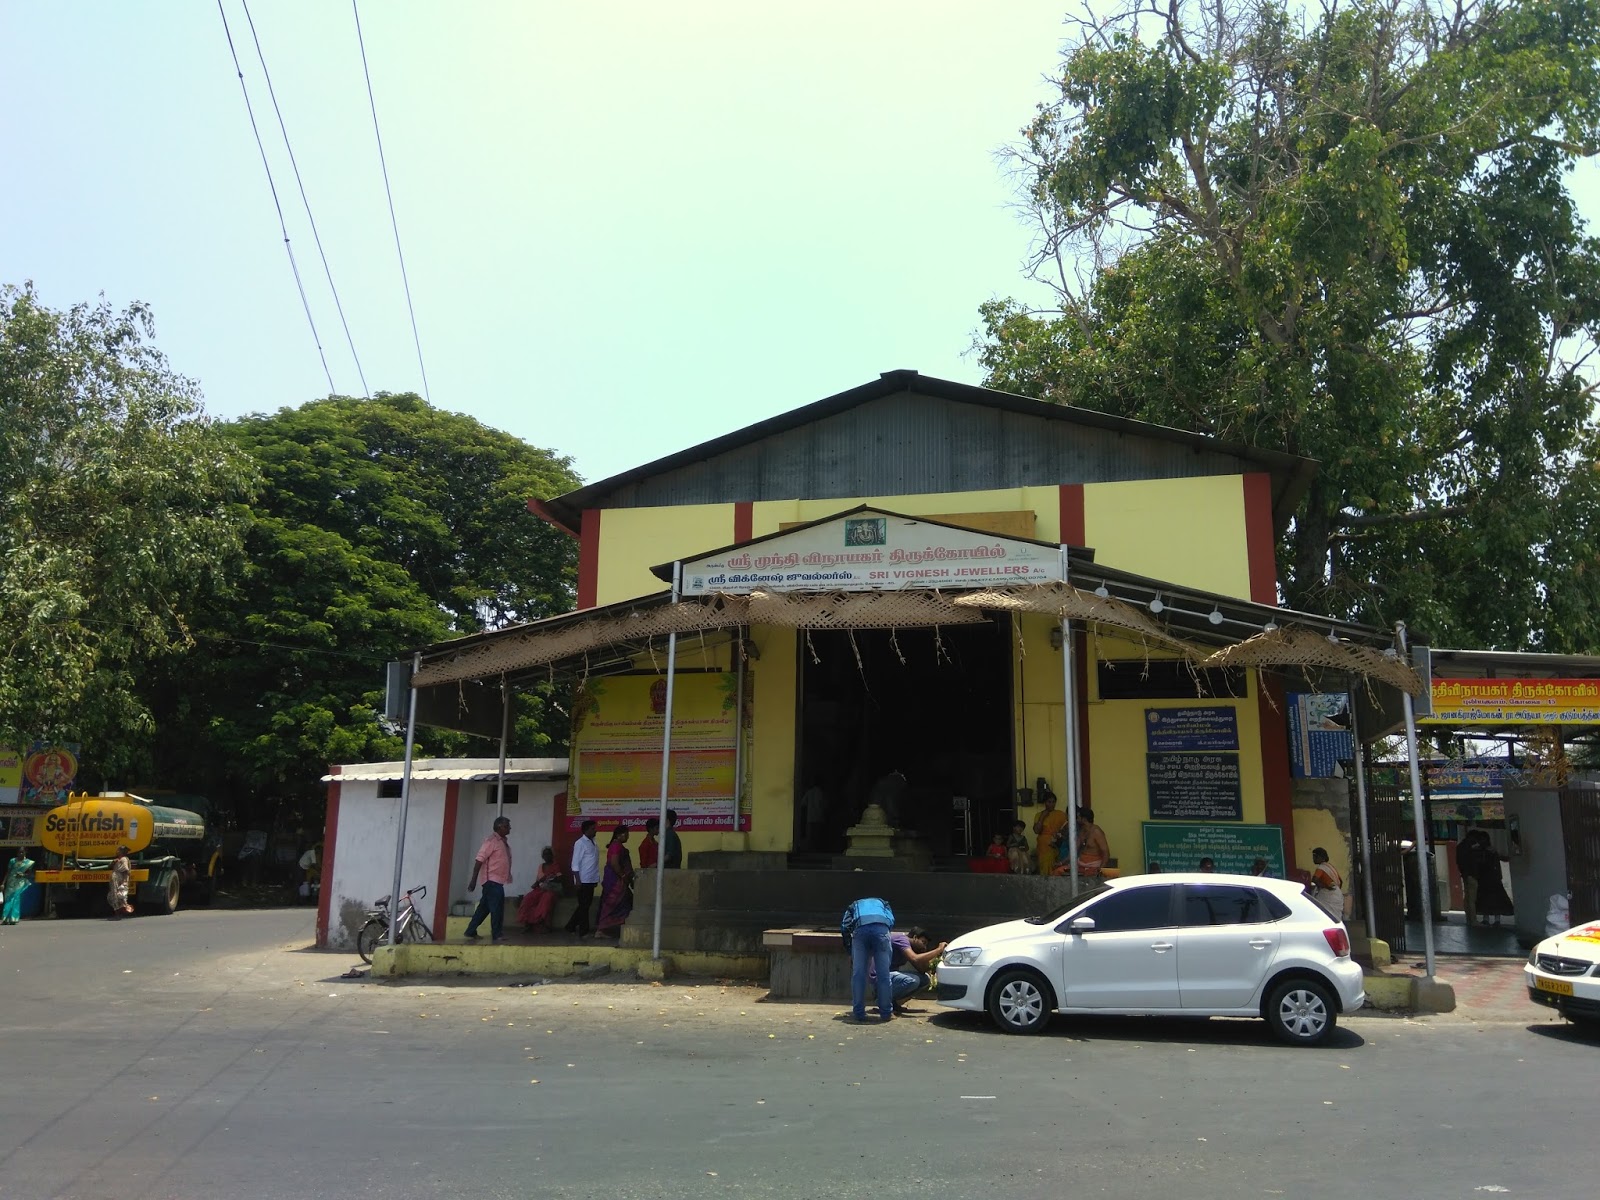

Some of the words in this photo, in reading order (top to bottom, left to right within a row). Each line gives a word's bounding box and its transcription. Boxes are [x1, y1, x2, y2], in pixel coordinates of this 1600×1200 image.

[754, 552, 799, 571] முந்தி
[802, 549, 884, 569] விநாயகர்
[728, 571, 784, 584] விக்னேஷ்
[869, 571, 889, 580] SRI
[893, 569, 950, 579] VIGNESH
[953, 565, 1030, 577] JEWELLERS
[1512, 681, 1598, 698] திருக்கோவில்
